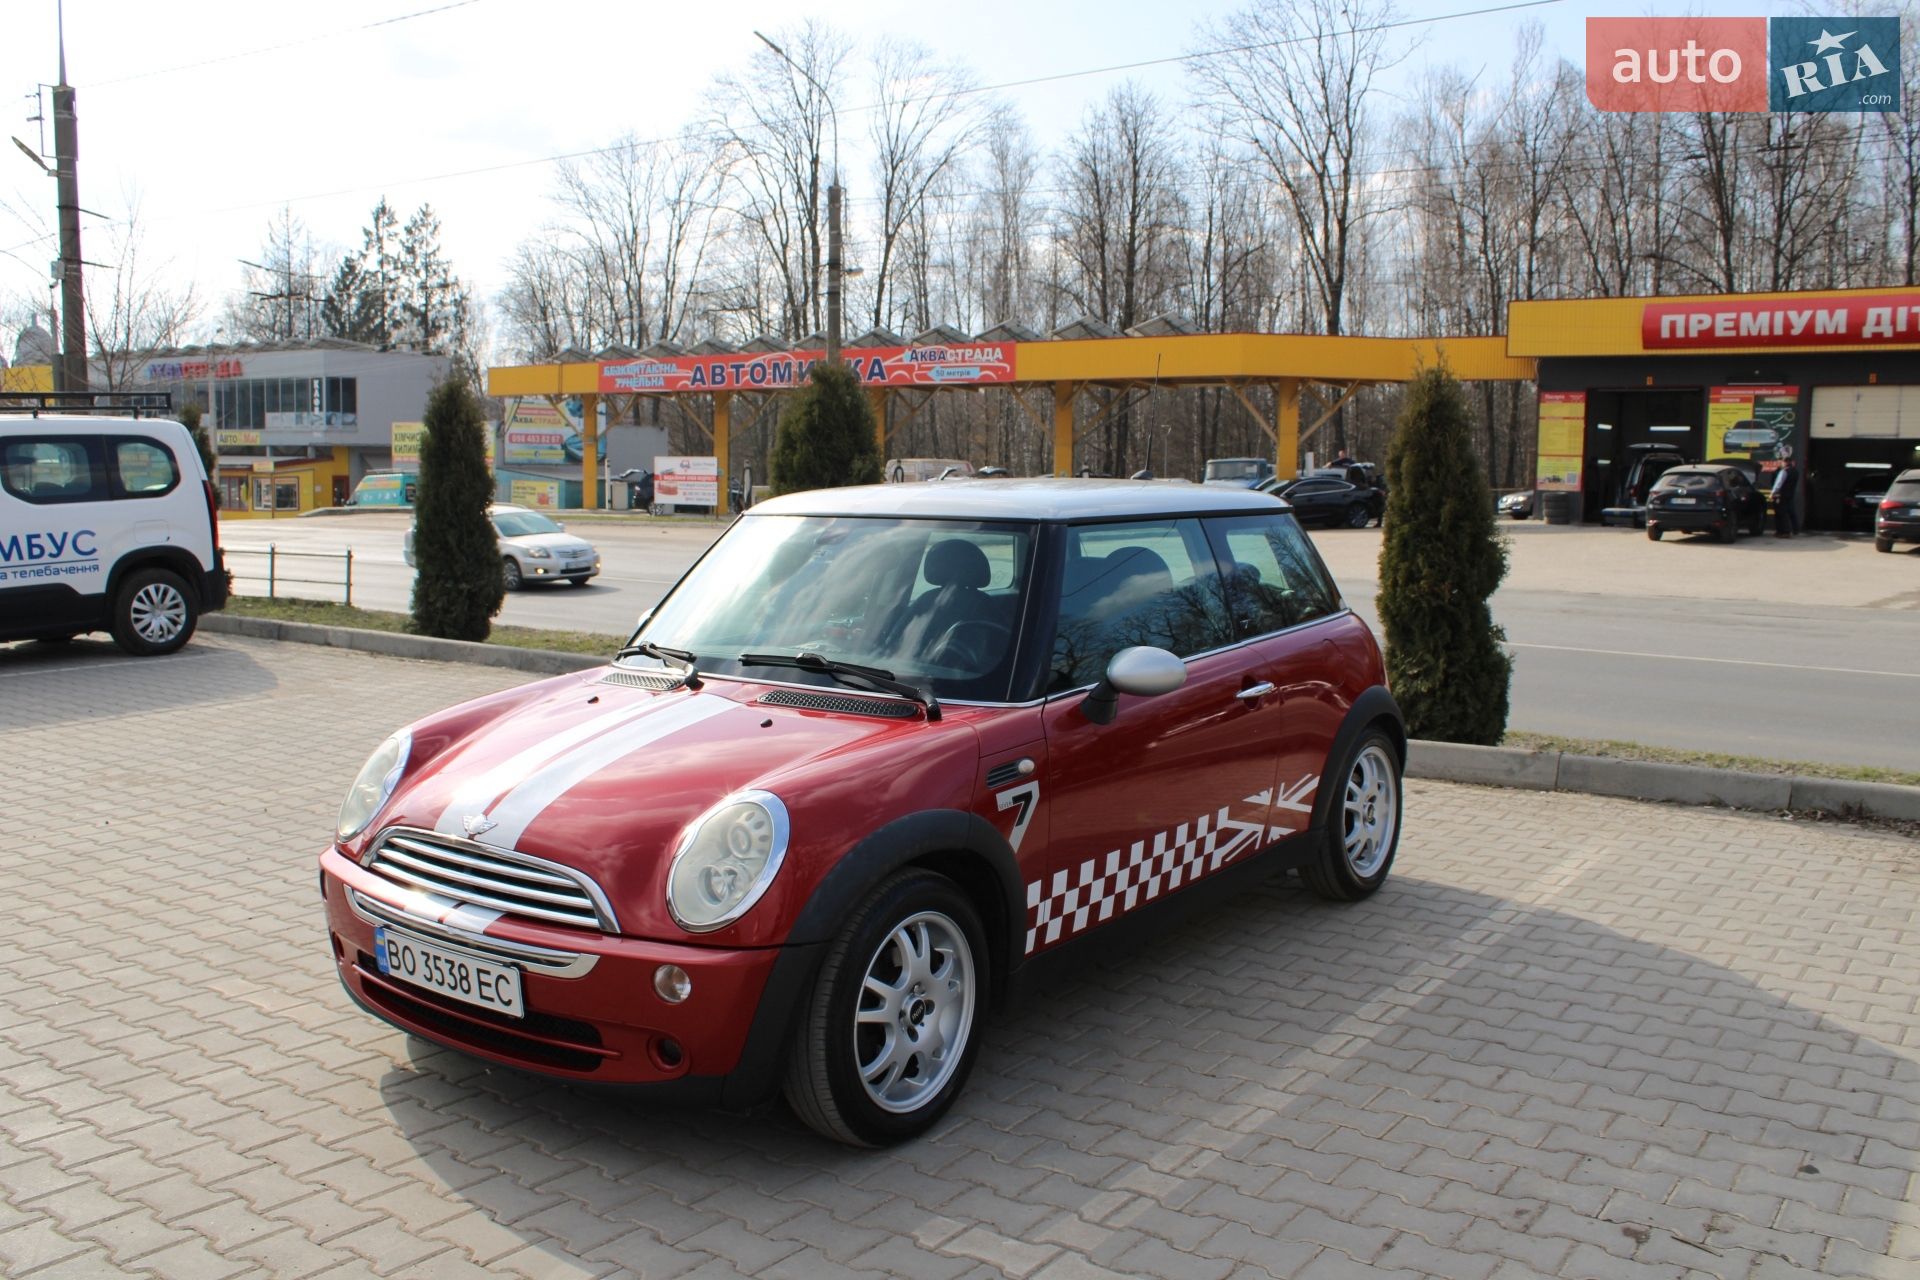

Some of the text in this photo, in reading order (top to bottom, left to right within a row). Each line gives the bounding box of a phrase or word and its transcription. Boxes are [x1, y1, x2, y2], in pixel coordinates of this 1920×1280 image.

[1660, 308, 1848, 339] ПРЕМІУМ
[909, 347, 1004, 363] АКВАСТРАДА
[688, 357, 889, 387] АВТОМИКА
[11, 563, 100, 579] телебачення
[387, 939, 513, 1007] BO 3538 EC
